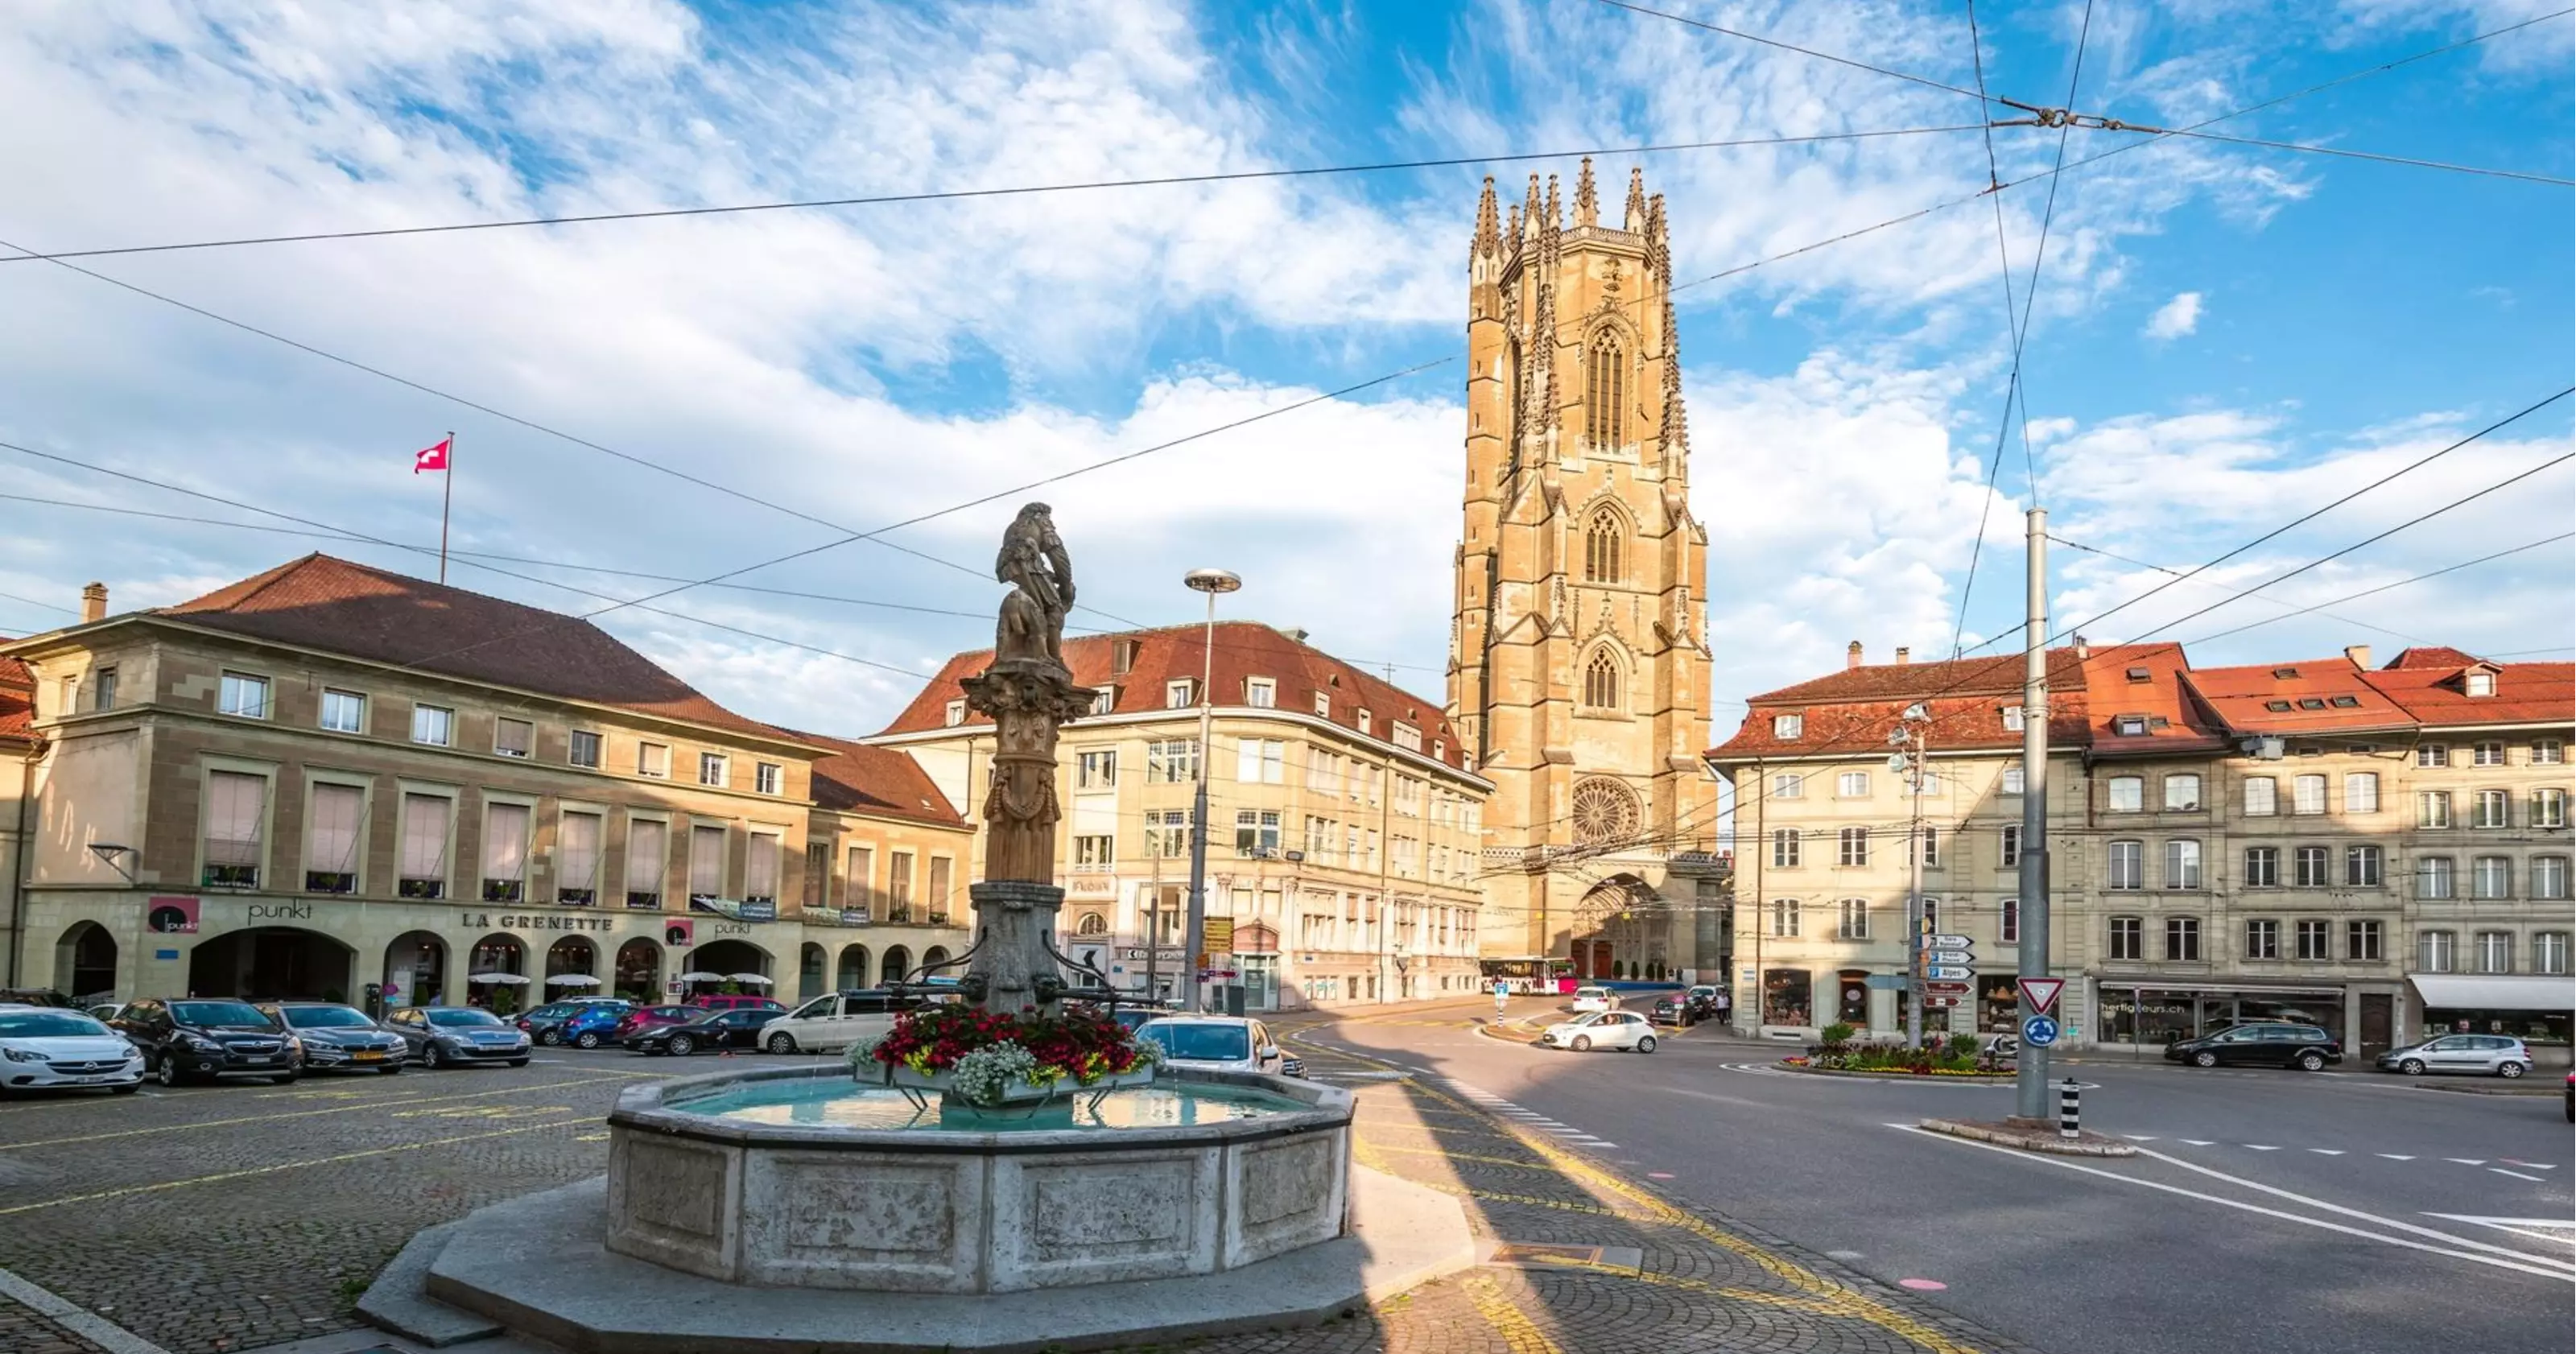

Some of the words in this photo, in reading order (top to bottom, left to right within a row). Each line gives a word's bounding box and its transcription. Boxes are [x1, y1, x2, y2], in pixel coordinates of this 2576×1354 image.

[248, 897, 312, 927] punkt
[164, 913, 198, 934] punkt
[462, 913, 490, 927] LA
[501, 915, 613, 931] GRENETTE
[714, 921, 751, 940] punkt
[2100, 1001, 2186, 1014] hertigeurs.ch
